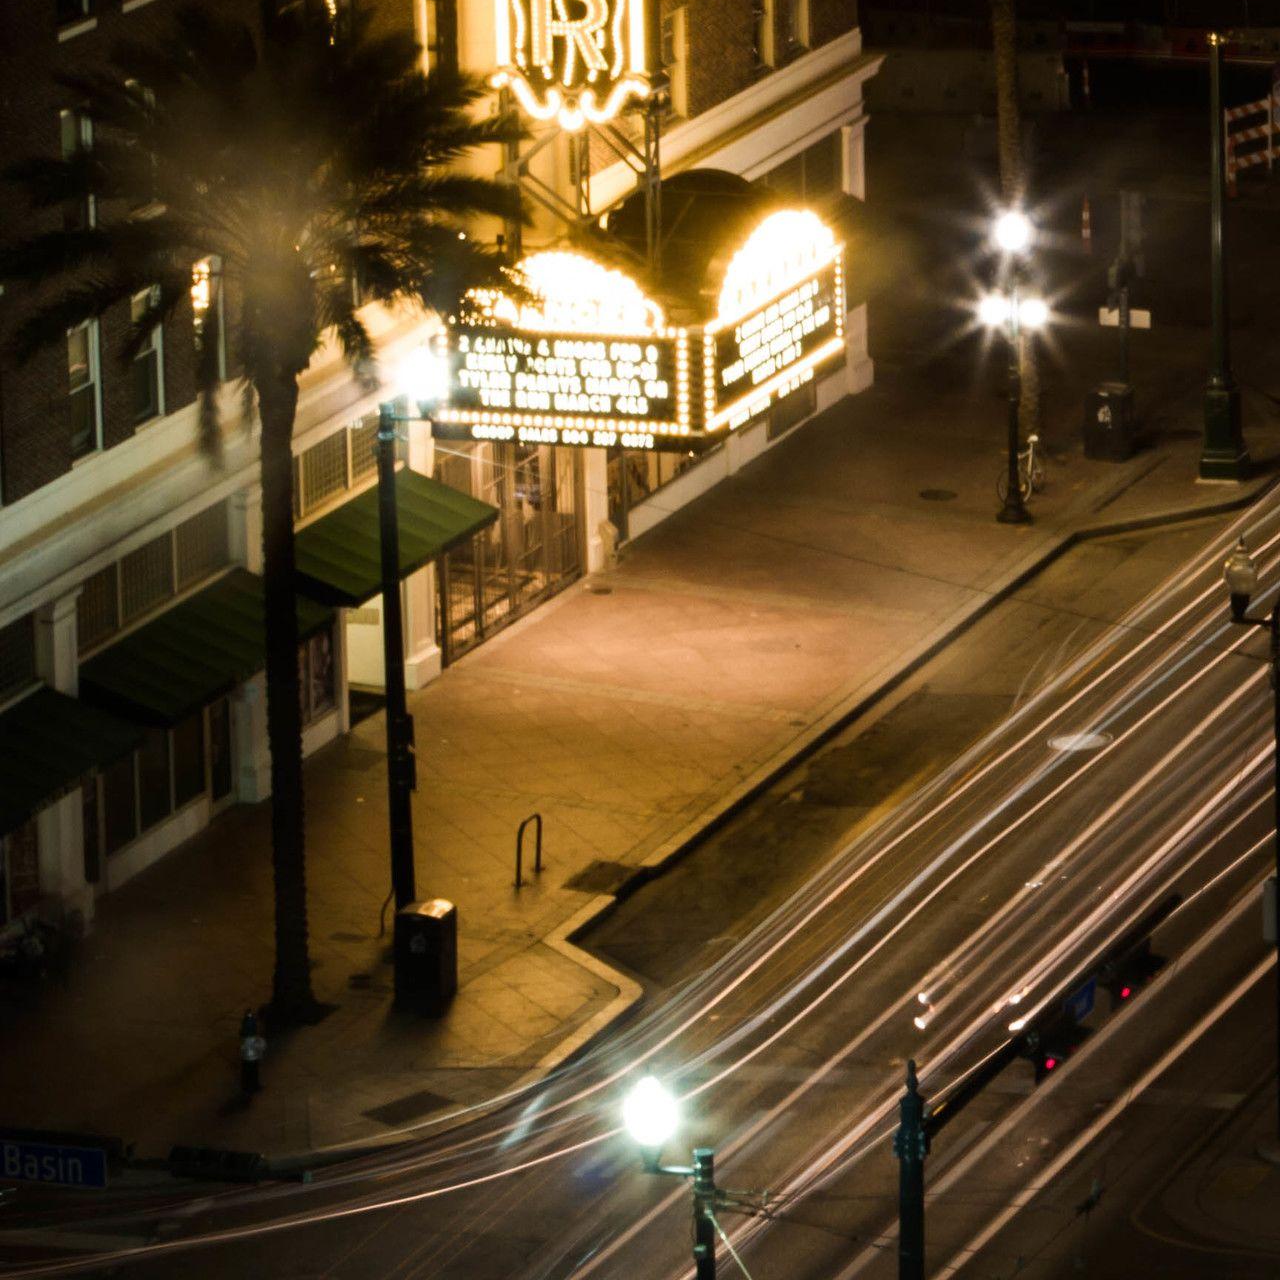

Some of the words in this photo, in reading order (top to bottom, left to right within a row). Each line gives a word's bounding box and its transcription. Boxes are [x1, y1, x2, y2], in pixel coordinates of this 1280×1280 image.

[459, 369, 511, 389] TYLER
[479, 388, 511, 407] THE
[515, 390, 550, 409] RUN
[554, 393, 610, 411] MARCH
[472, 425, 515, 439] GROUP
[519, 427, 558, 442] SALES
[4, 1144, 83, 1183] Basin
